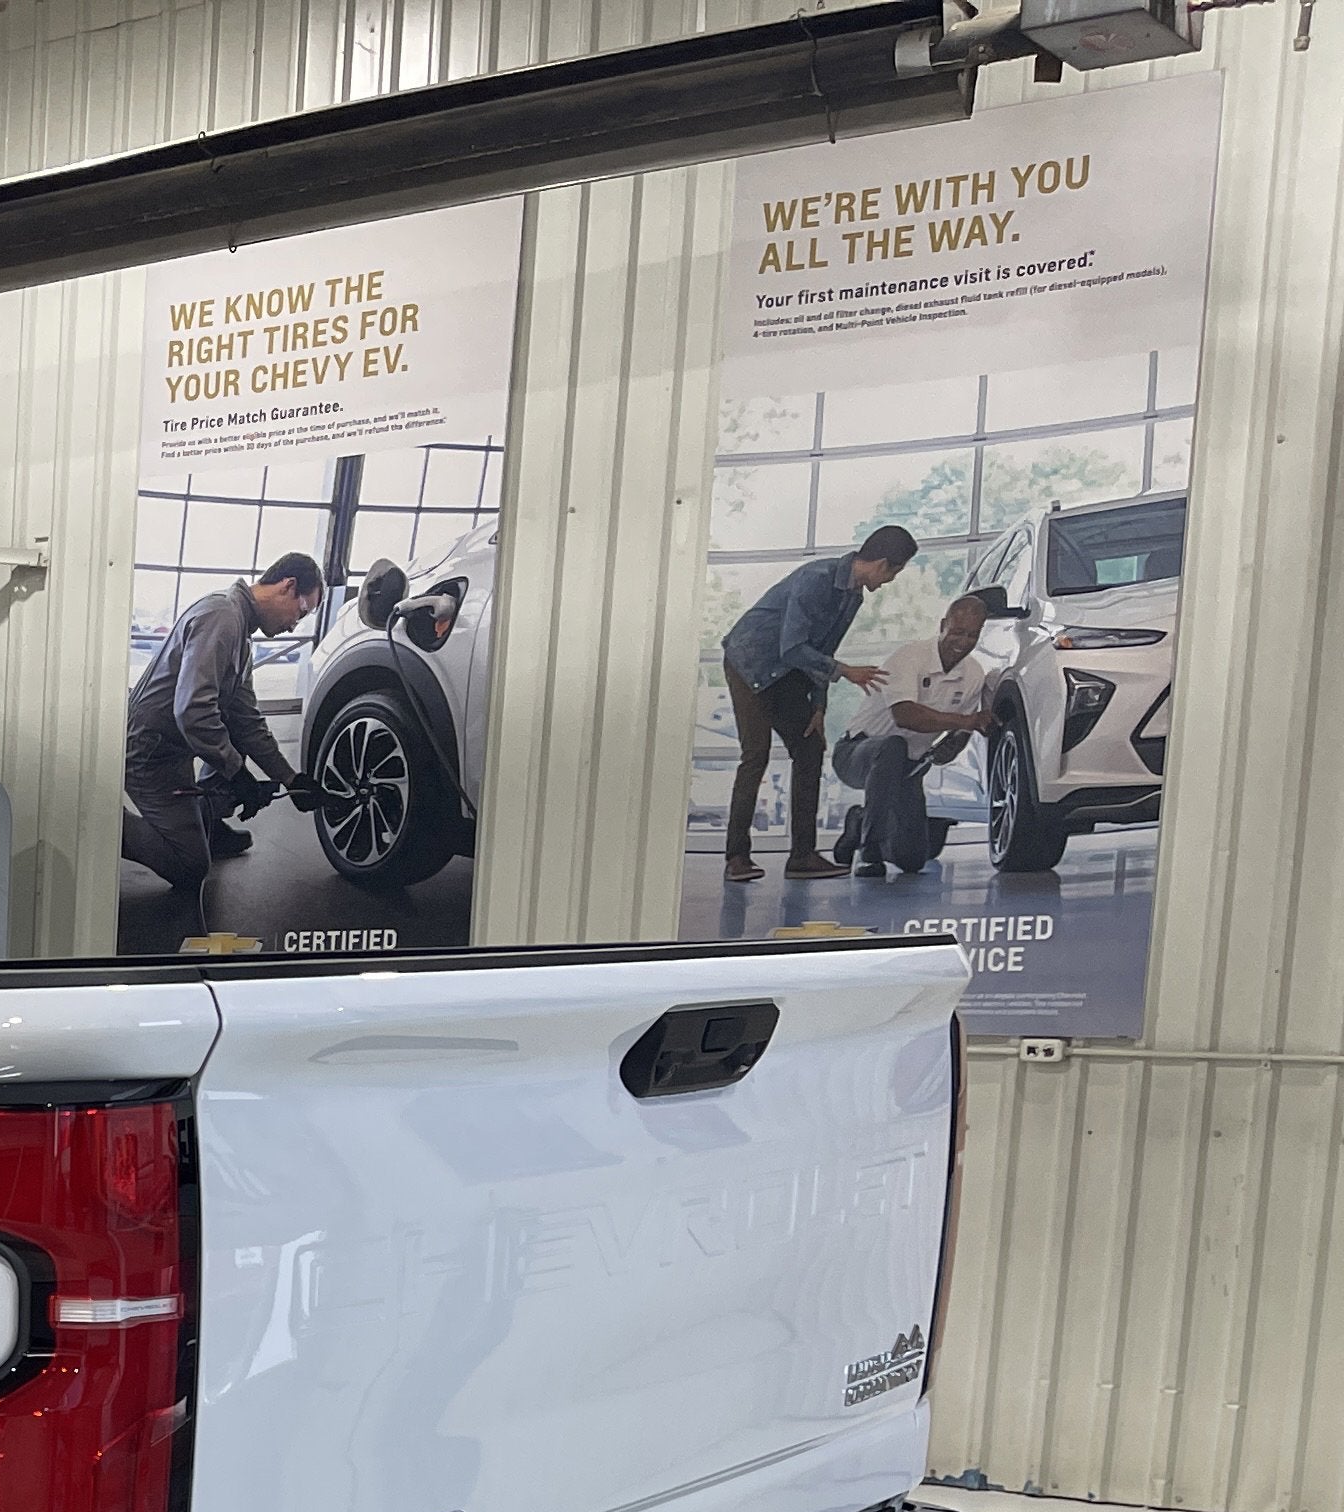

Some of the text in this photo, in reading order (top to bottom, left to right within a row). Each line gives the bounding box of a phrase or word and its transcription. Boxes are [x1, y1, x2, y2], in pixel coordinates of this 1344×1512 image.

[763, 154, 1091, 233] WE'RE WITH YOU
[758, 210, 1020, 275] ALL THE WAY.
[170, 270, 385, 331] WE KNOW THE
[756, 294, 793, 309] Your
[798, 288, 834, 305] first
[839, 276, 949, 300] maintenance
[954, 267, 991, 286] visit
[996, 265, 1011, 281] is
[167, 303, 420, 367] RIGHT TIRES FOR
[806, 313, 822, 322] and
[817, 323, 833, 333] and
[886, 313, 917, 325] Vehicle
[165, 343, 408, 404] YOUR CHEVY EV.
[163, 402, 344, 432] Tire Price Match Guarantee.
[283, 929, 398, 954] CERTIFIED
